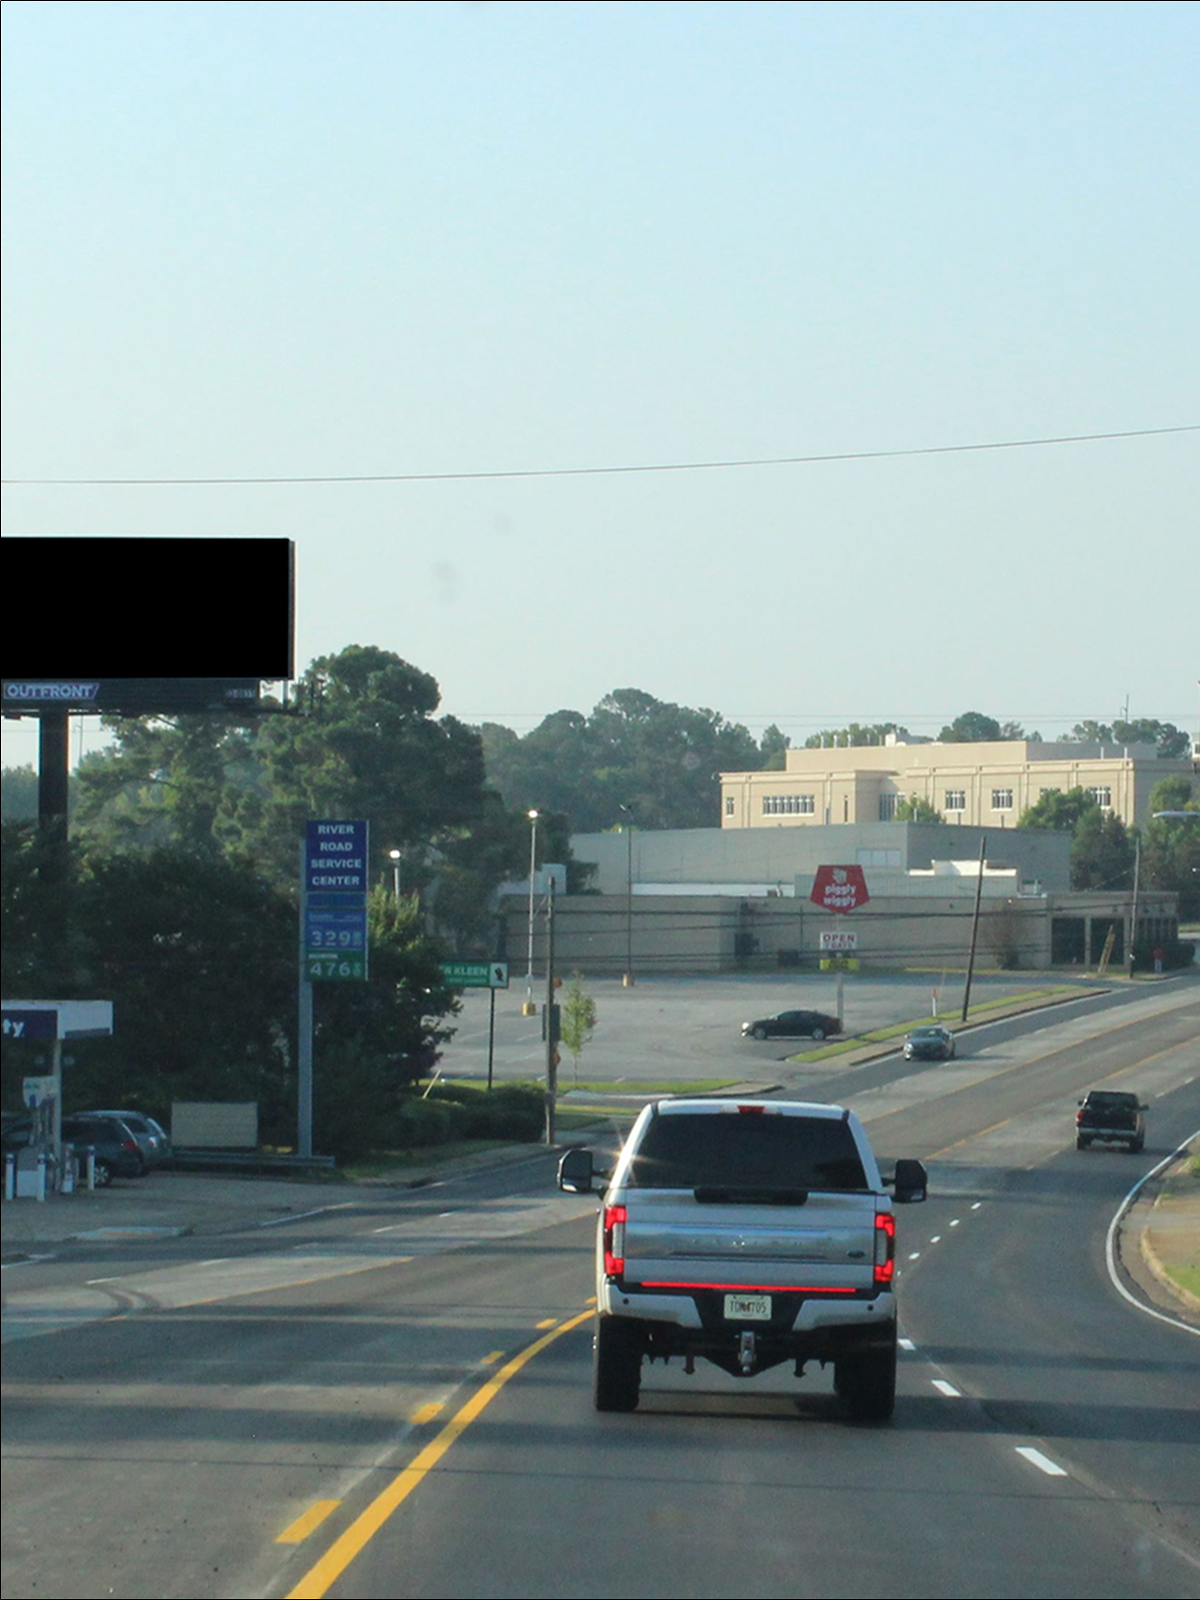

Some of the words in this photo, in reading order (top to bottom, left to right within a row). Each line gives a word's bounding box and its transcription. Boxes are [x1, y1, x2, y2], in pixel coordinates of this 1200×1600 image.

[7, 684, 94, 698] OUTFRONT
[318, 824, 354, 835] RIVER
[320, 842, 353, 852] ROAD
[311, 859, 362, 869] SERVICE
[312, 876, 360, 886] CENTER
[825, 884, 856, 895] piggly
[823, 896, 856, 907] wiggly
[823, 934, 855, 942] OPEN
[453, 966, 488, 976] KLEEN
